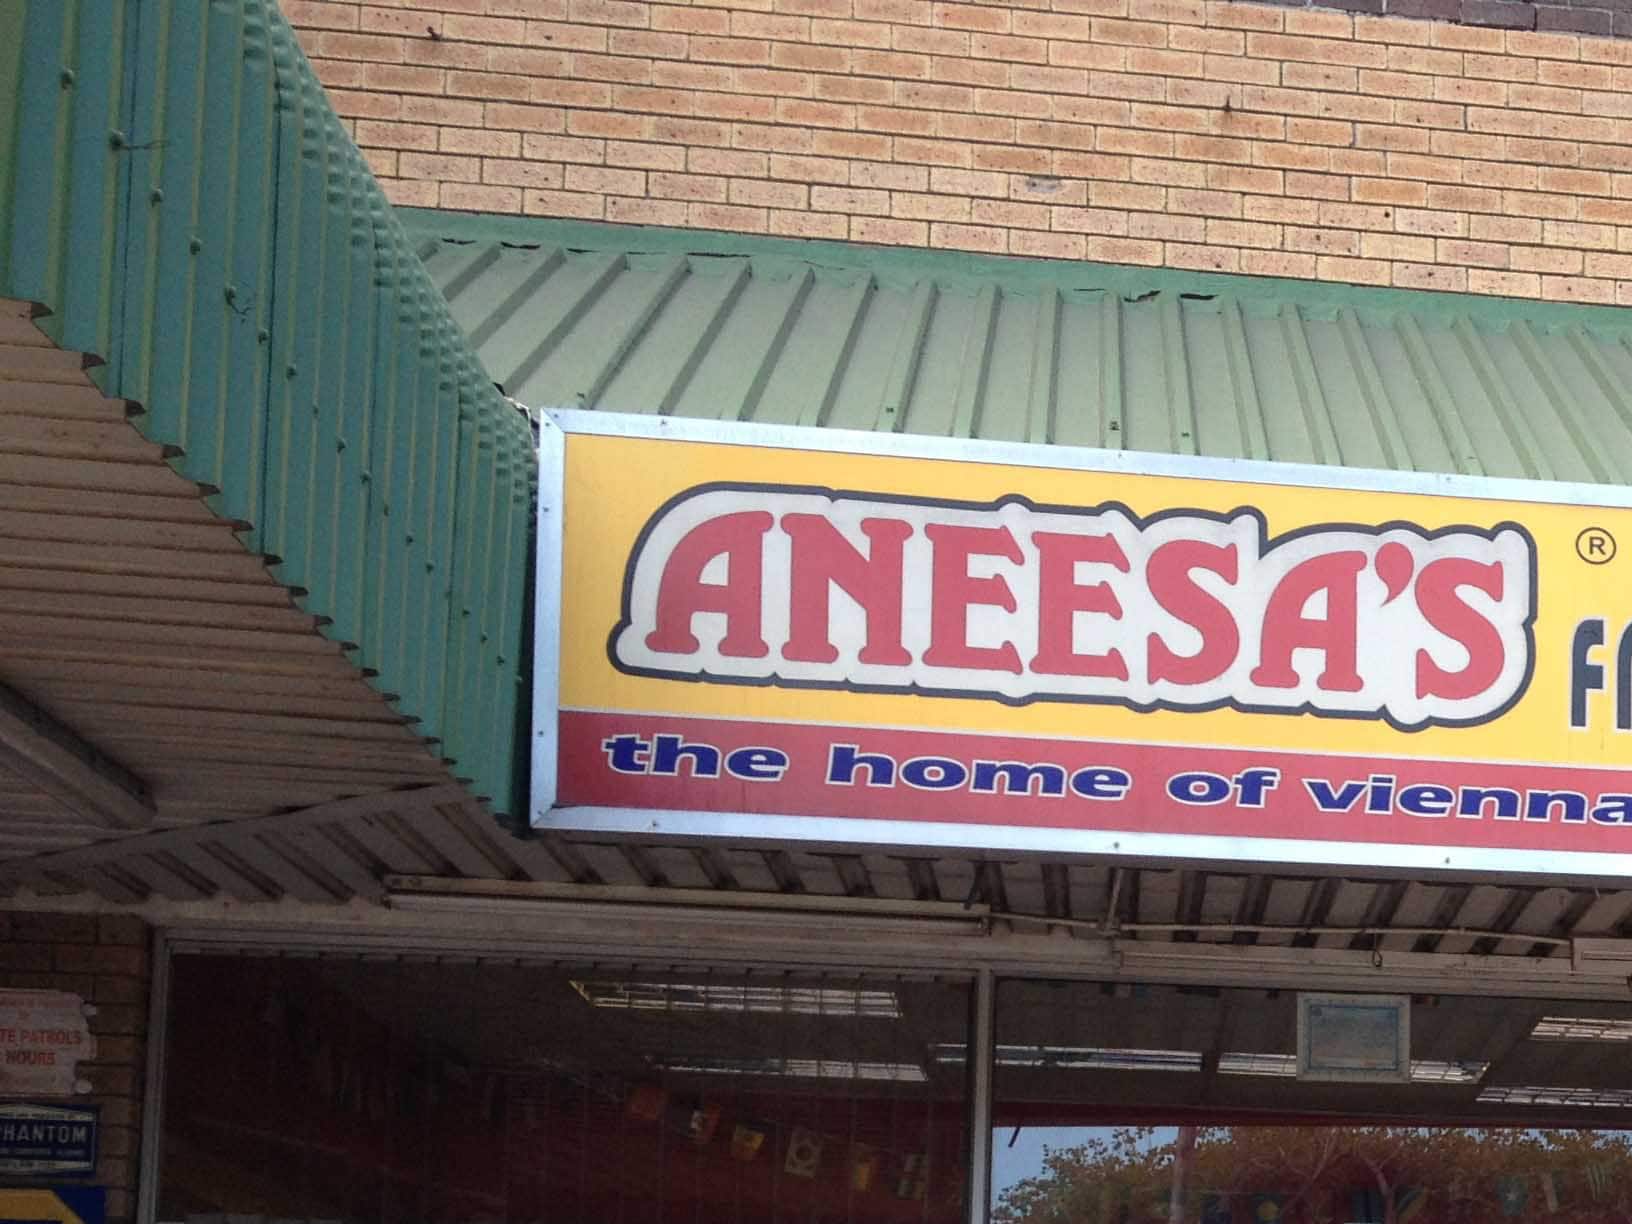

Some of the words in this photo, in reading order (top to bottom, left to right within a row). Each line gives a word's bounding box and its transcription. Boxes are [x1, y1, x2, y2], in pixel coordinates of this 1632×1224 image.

[645, 508, 1505, 702] ANEESA'S
[602, 731, 786, 781] the
[825, 742, 1130, 801] home
[1165, 766, 1280, 810] of
[0, 1123, 87, 1144] HANTOM
